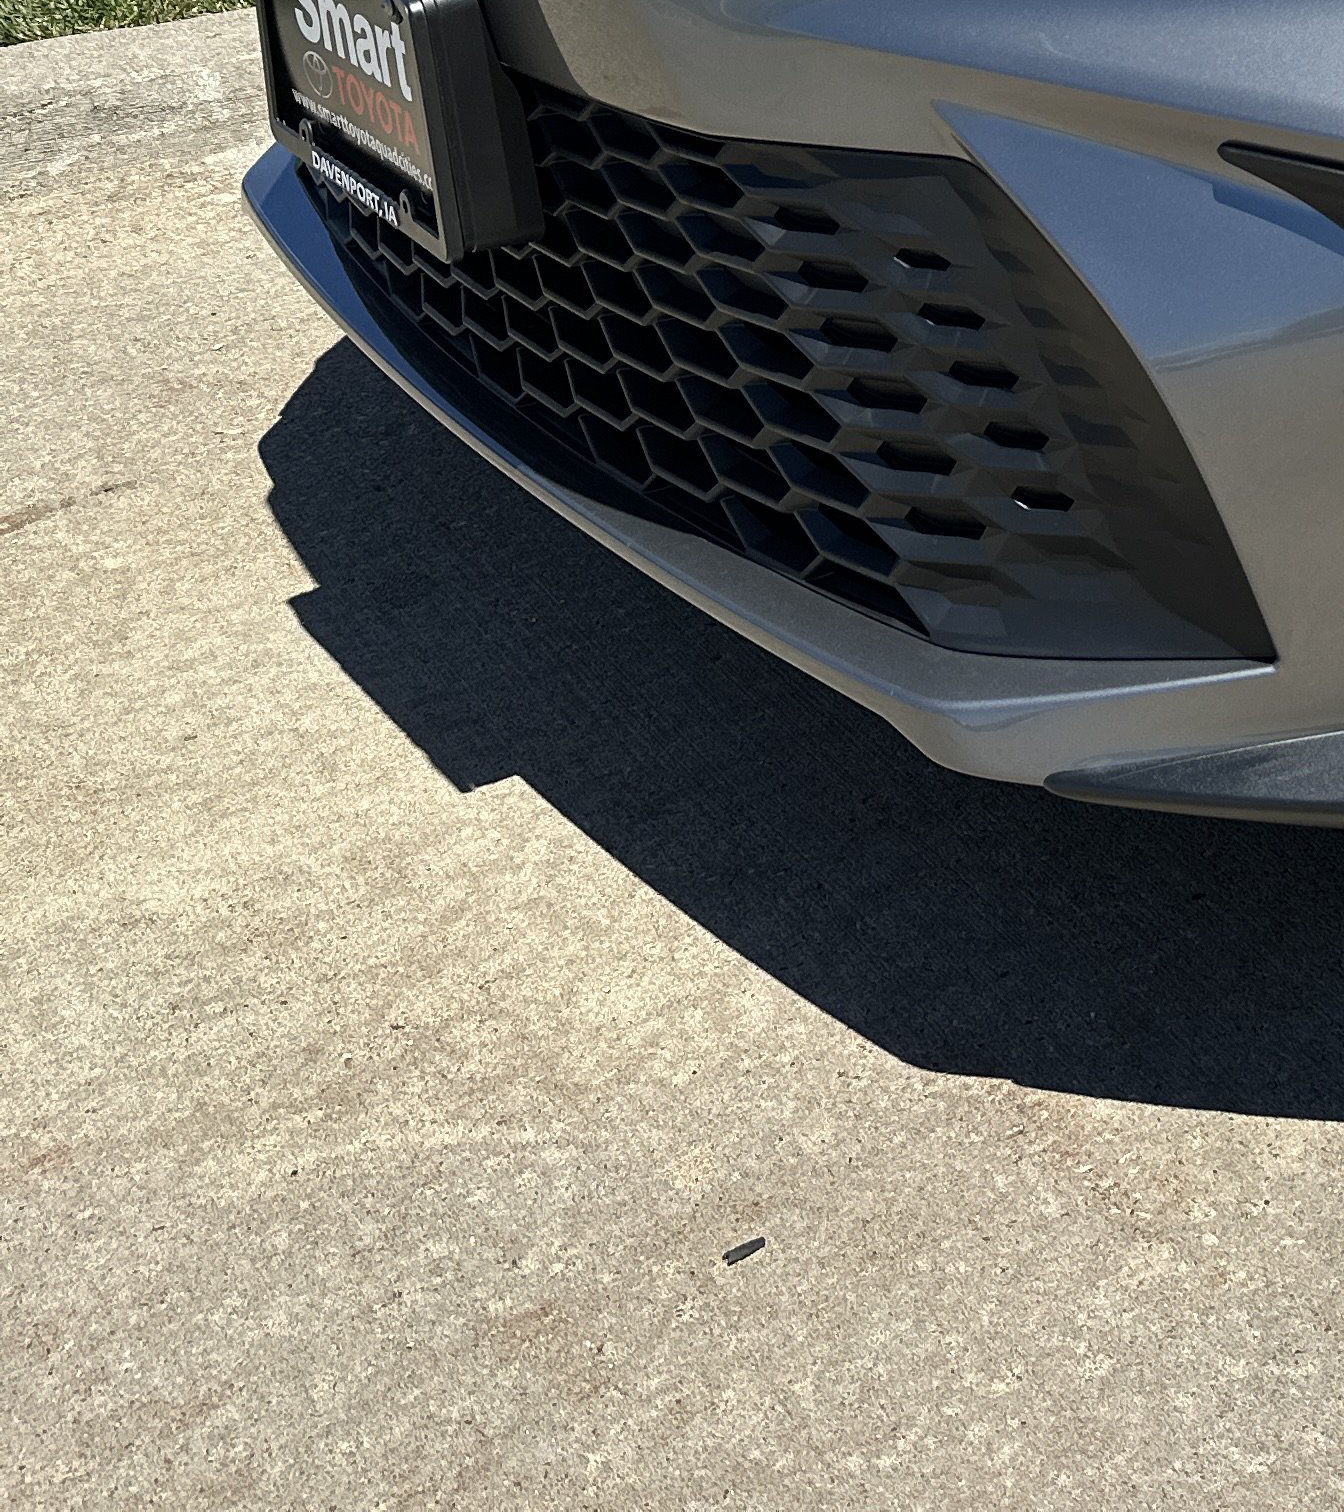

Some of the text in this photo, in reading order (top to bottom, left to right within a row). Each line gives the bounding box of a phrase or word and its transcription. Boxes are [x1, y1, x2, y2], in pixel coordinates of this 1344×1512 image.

[331, 65, 422, 156] TOYOTA
[311, 150, 399, 227] DAVENPORT, IA
